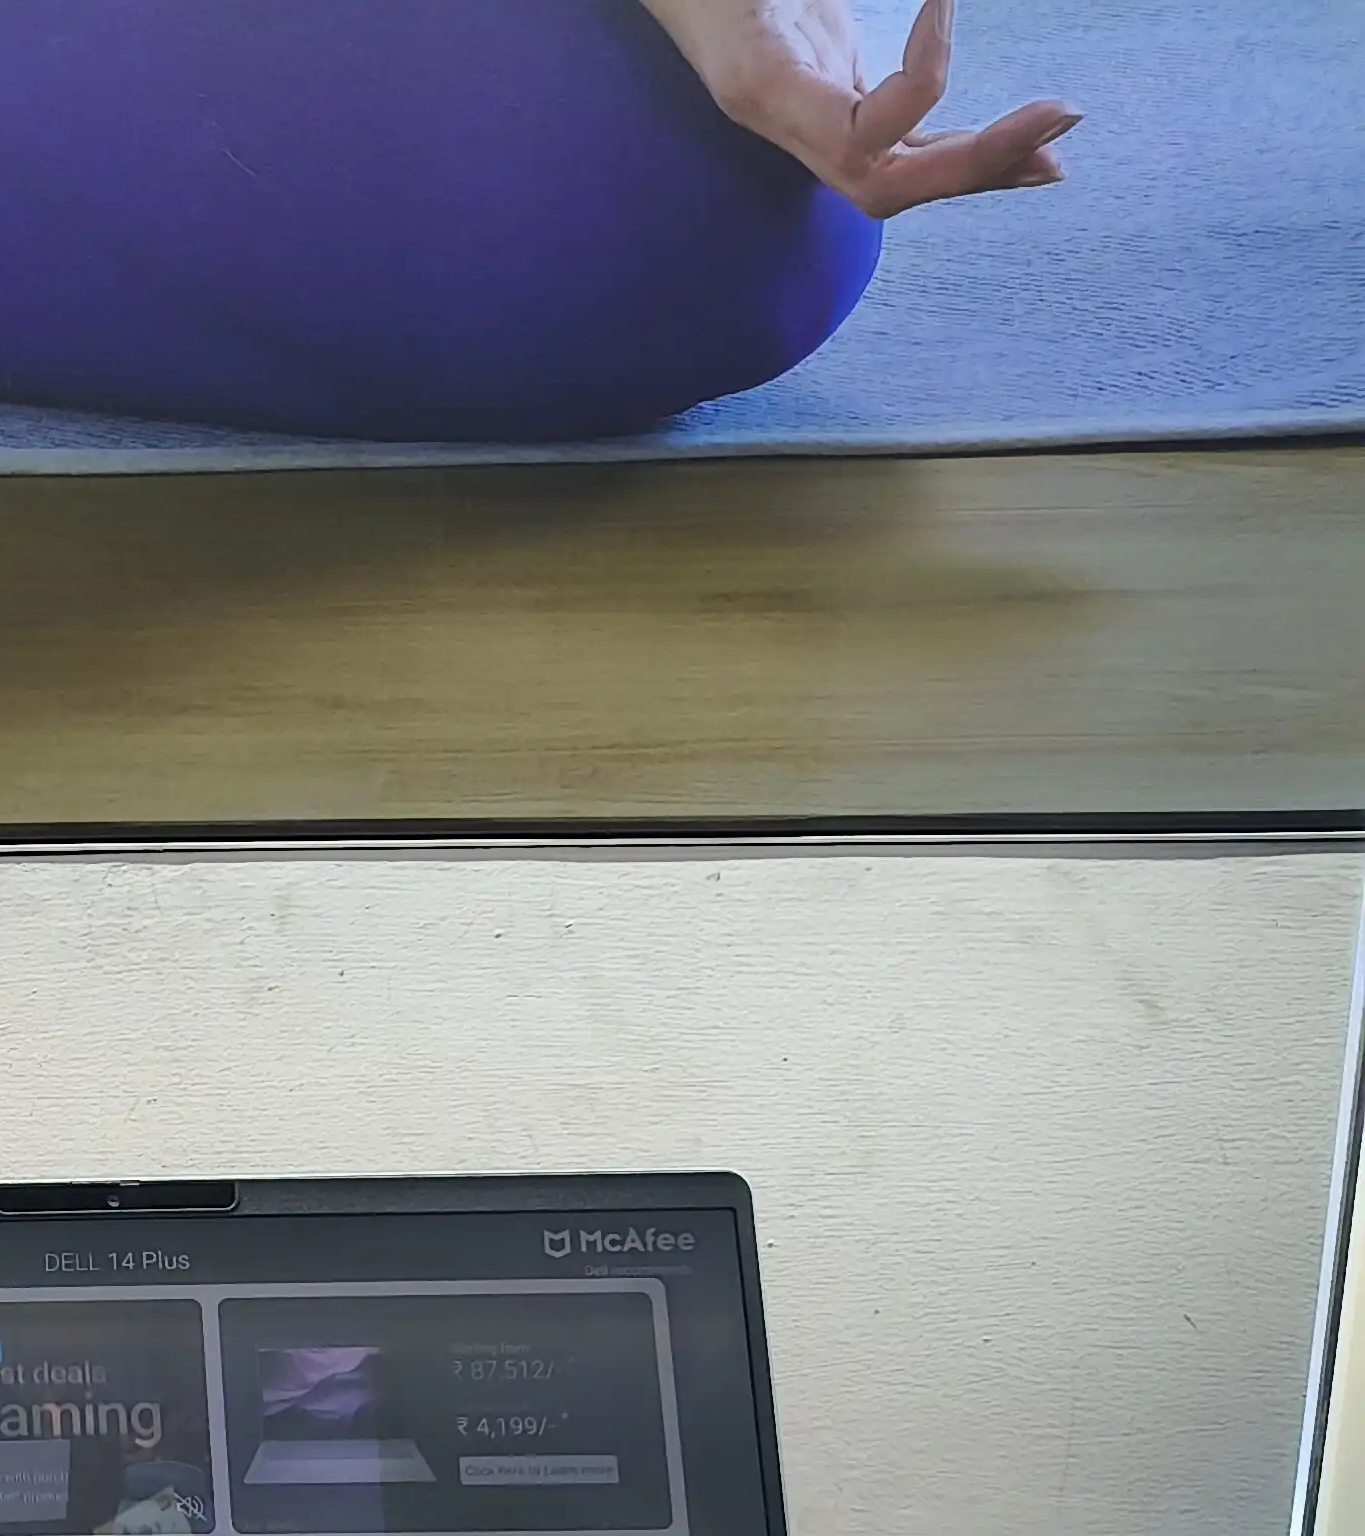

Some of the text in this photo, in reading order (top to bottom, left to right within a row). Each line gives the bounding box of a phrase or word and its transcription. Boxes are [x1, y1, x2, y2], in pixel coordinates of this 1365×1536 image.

[579, 1227, 696, 1252] McAfee
[45, 1249, 190, 1271] DELL 14 Plus
[33, 1360, 107, 1385] deals
